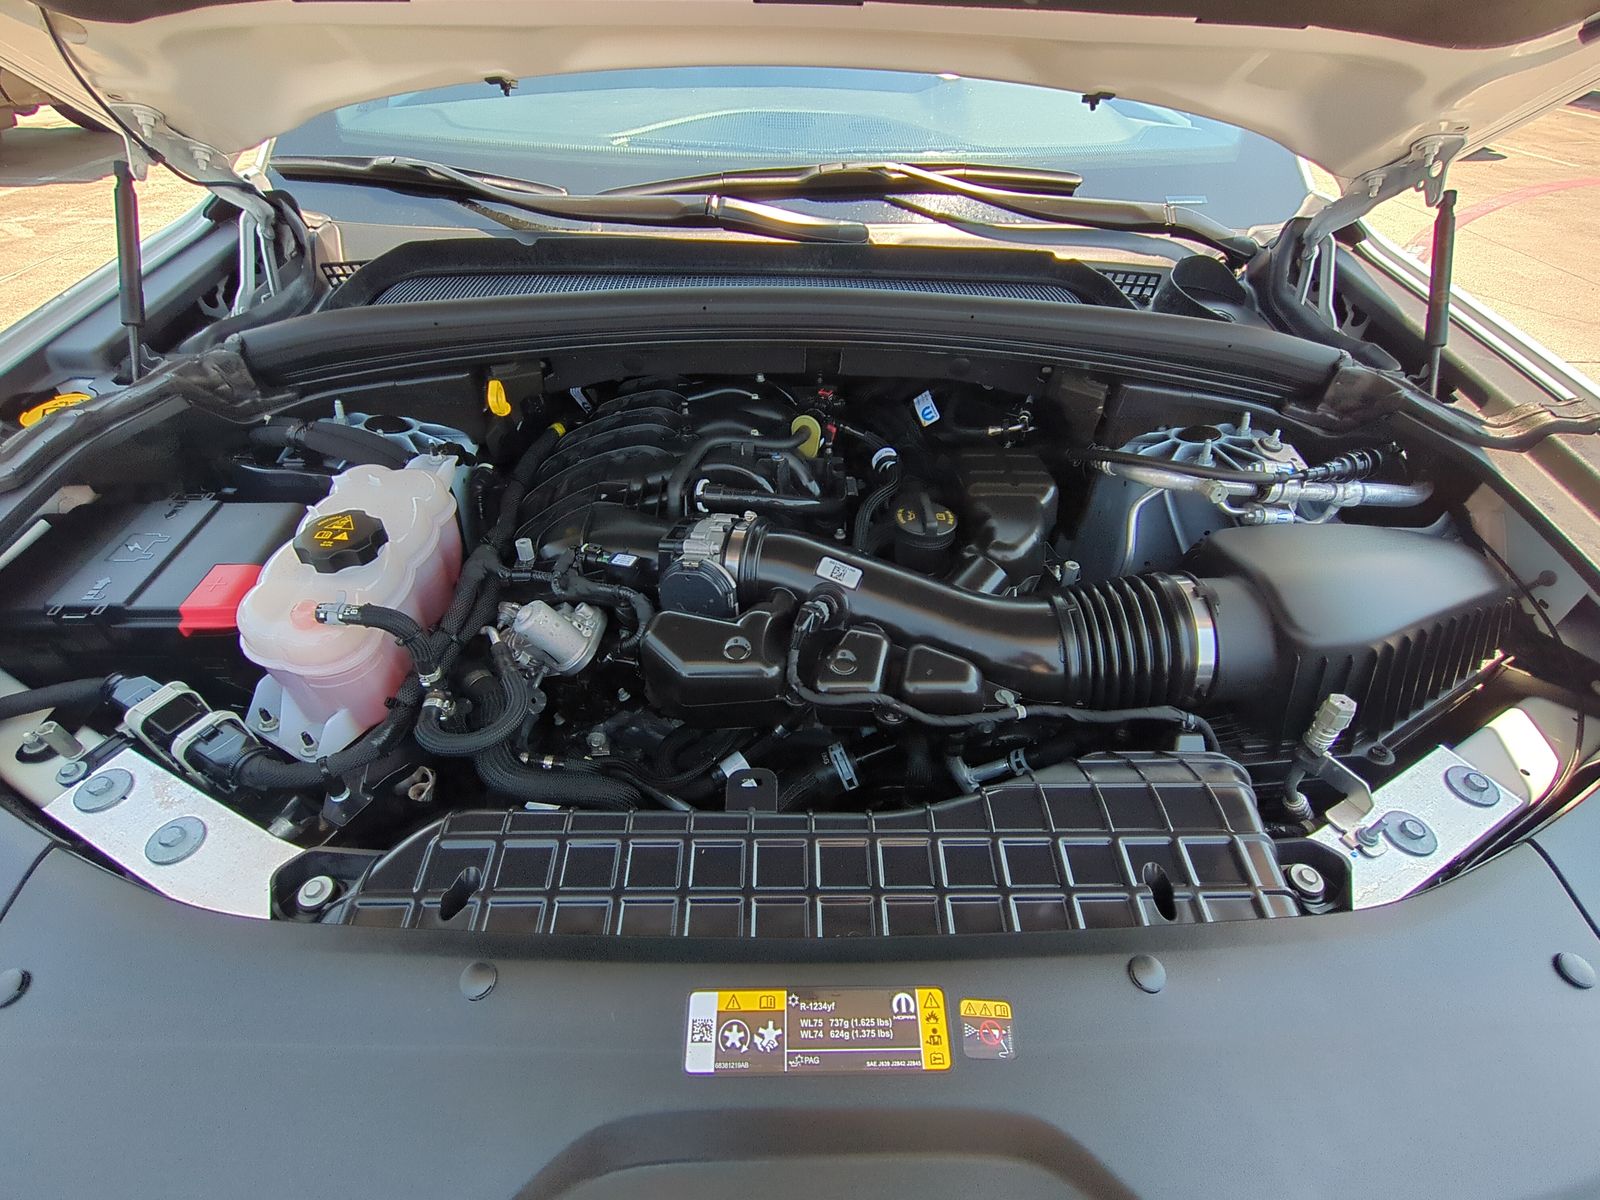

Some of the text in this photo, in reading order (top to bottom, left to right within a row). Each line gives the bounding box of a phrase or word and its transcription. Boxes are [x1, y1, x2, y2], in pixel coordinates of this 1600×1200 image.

[800, 1002, 835, 1012] R-1234yf
[800, 1018, 892, 1028] WL75 737g (1.625 lbs)
[800, 1029, 893, 1039] WL74 624g (1.375 lbs)
[804, 1056, 820, 1064] PAG
